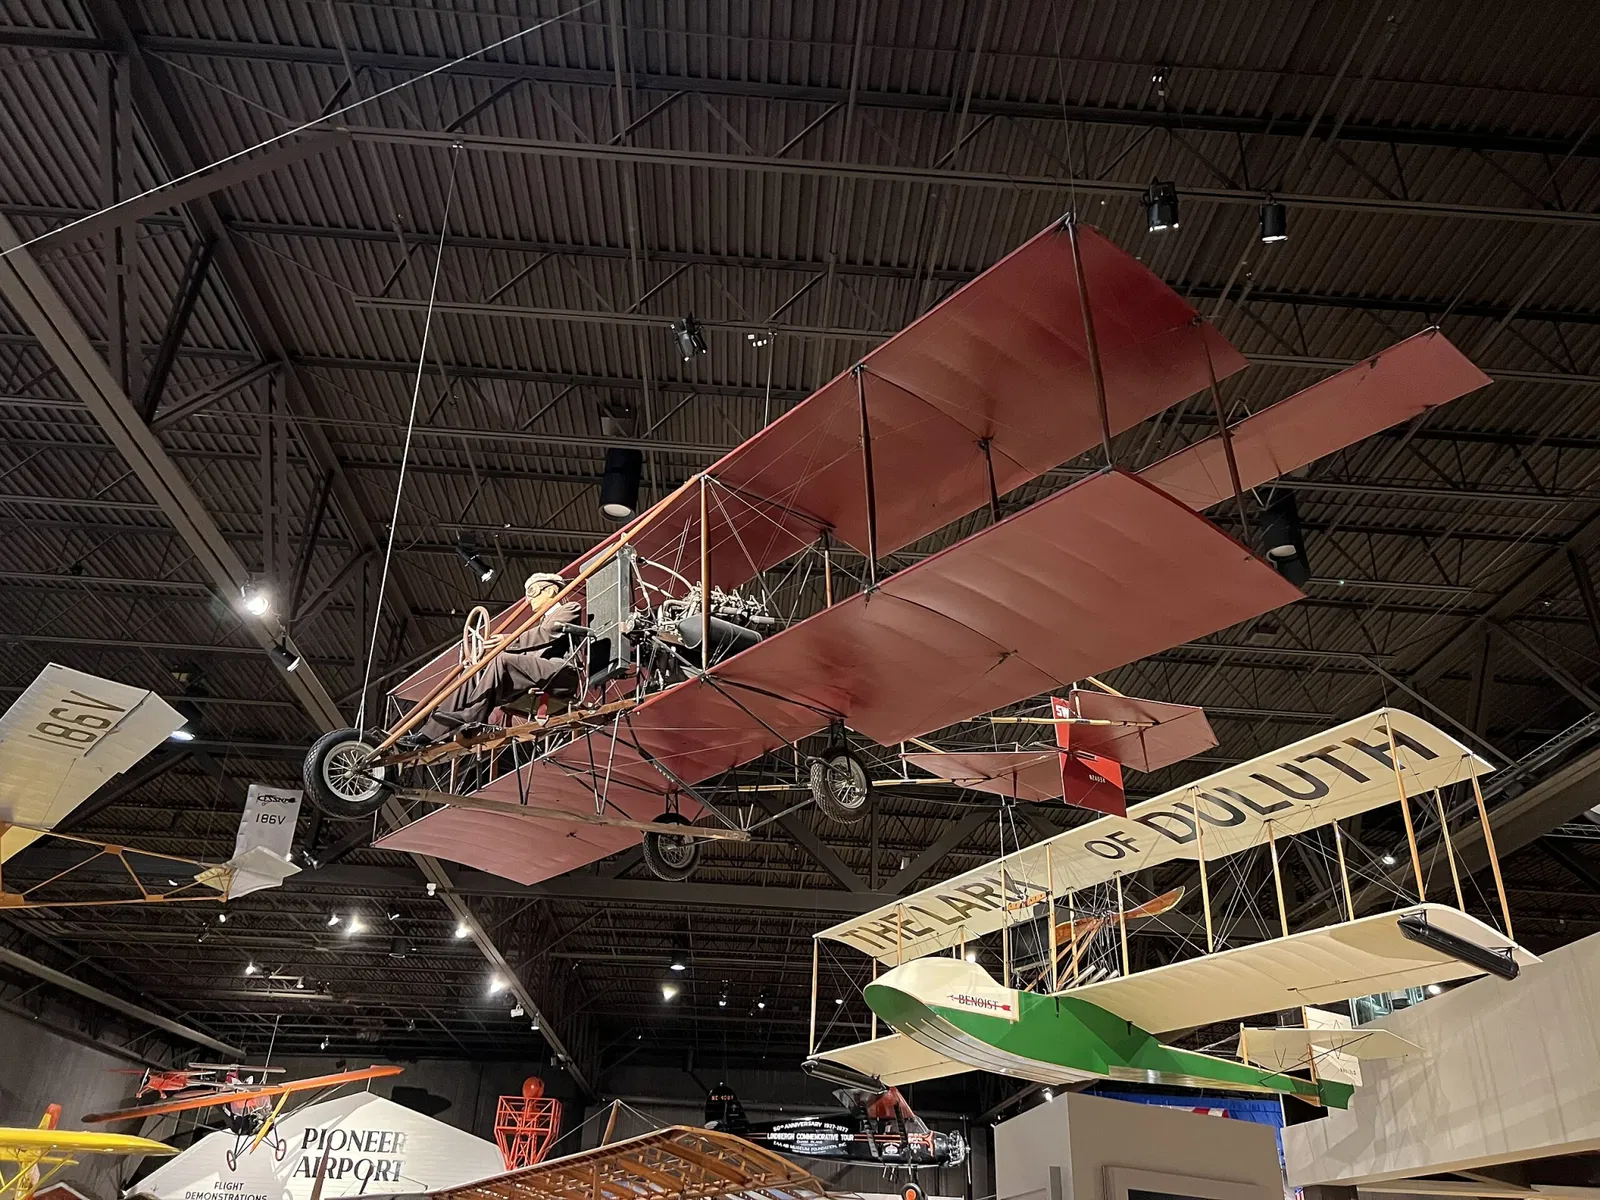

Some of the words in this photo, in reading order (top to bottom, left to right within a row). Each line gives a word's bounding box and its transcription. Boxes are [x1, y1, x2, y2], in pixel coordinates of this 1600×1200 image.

[28, 690, 126, 750] 186V
[255, 813, 286, 825] 186V
[838, 912, 935, 950] THE
[909, 869, 1049, 926] LARK
[1084, 830, 1141, 860] OF
[1132, 725, 1440, 845] DULUTH
[958, 994, 1000, 1010] BENOIST
[784, 1121, 823, 1129] ANNIVERSARY
[301, 1128, 408, 1154] PIONEER
[766, 1132, 795, 1140] LINDBERGH
[796, 1133, 839, 1141] COMMEMORATIVE
[293, 1156, 405, 1182] AIRPORT
[214, 1181, 244, 1191] FLIGHT
[185, 1191, 268, 1200] DEMONSTRATIONS
